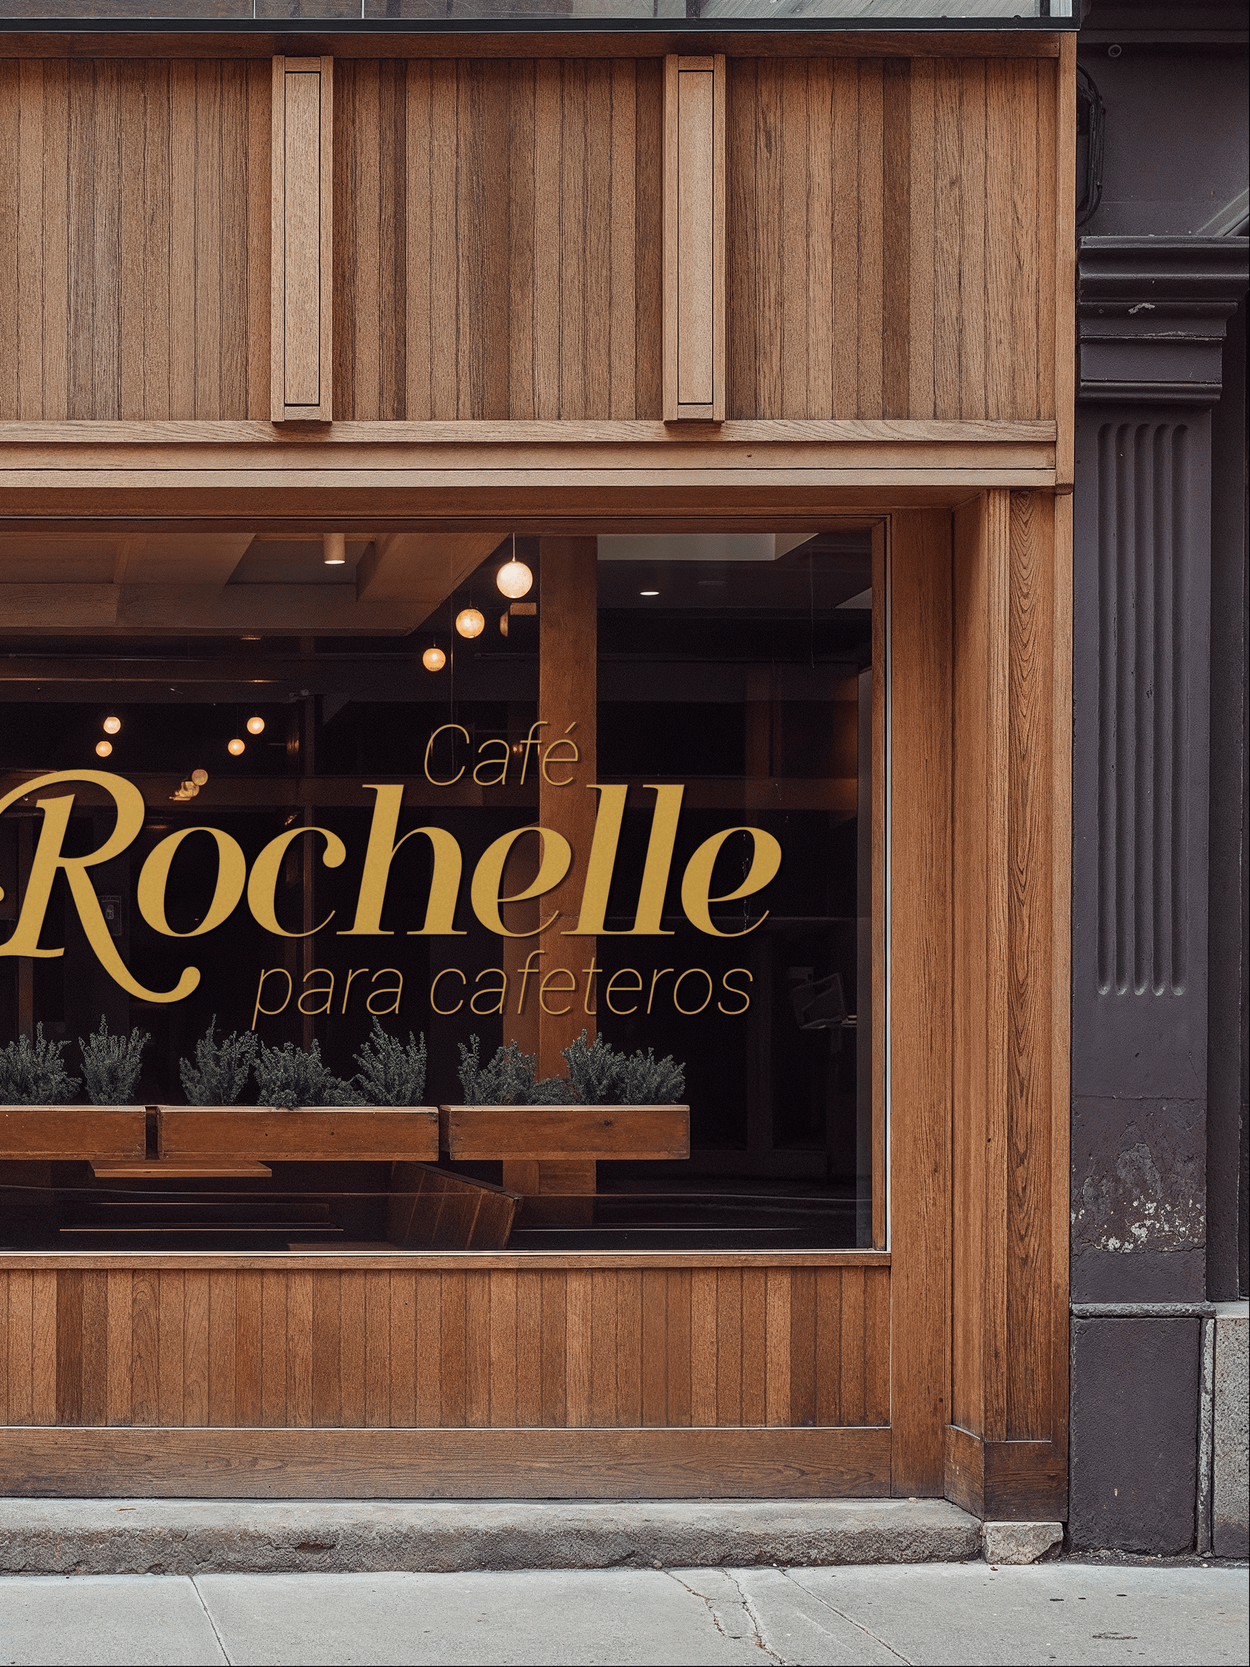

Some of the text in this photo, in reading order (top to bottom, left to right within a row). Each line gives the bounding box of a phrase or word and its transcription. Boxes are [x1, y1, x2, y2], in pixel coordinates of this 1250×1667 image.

[423, 721, 580, 787] Café
[250, 949, 755, 1030] para cafeteros
